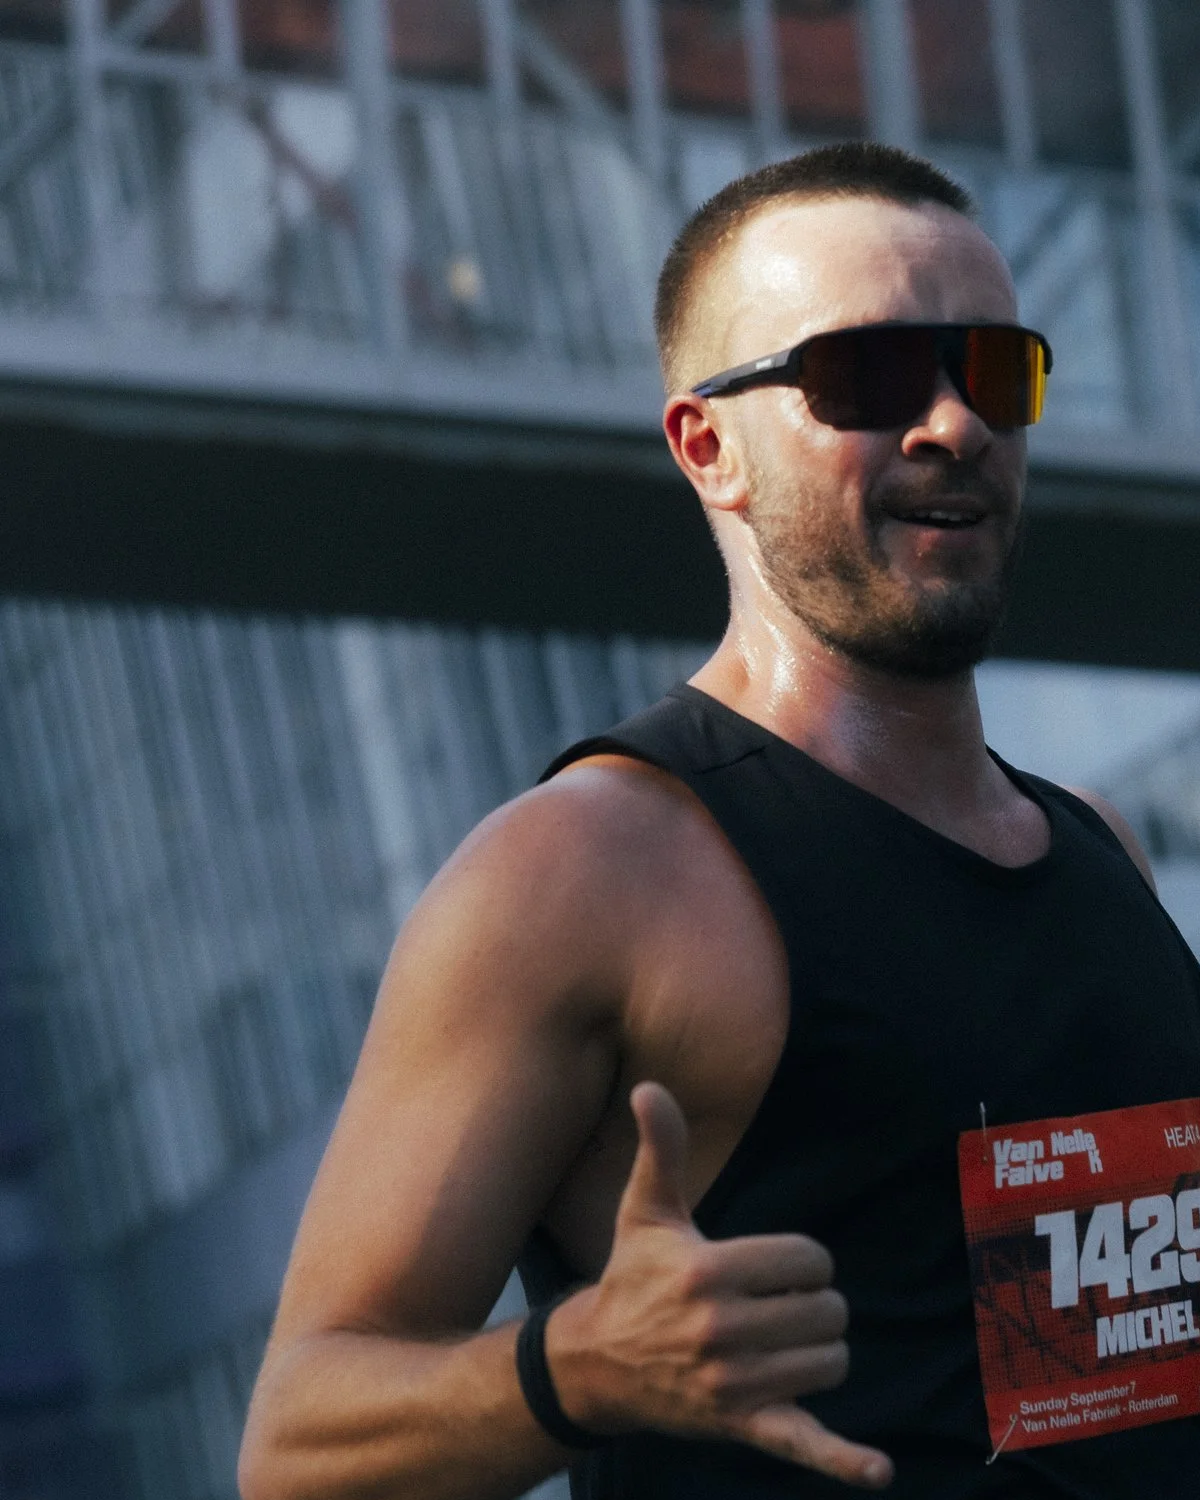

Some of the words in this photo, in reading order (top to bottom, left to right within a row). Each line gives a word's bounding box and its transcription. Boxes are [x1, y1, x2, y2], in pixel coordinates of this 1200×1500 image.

[993, 1138, 1044, 1163] Van
[1051, 1128, 1097, 1156] Nelle
[1096, 1299, 1200, 1358] MICHEL
[1020, 1397, 1068, 1415] Sunday
[1070, 1385, 1130, 1407] September
[1130, 1380, 1136, 1395] 7
[1021, 1418, 1047, 1433] Van
[1050, 1412, 1081, 1429] Nelle
[1082, 1404, 1121, 1423] Fabriek
[1128, 1393, 1179, 1414] Rotterdam
